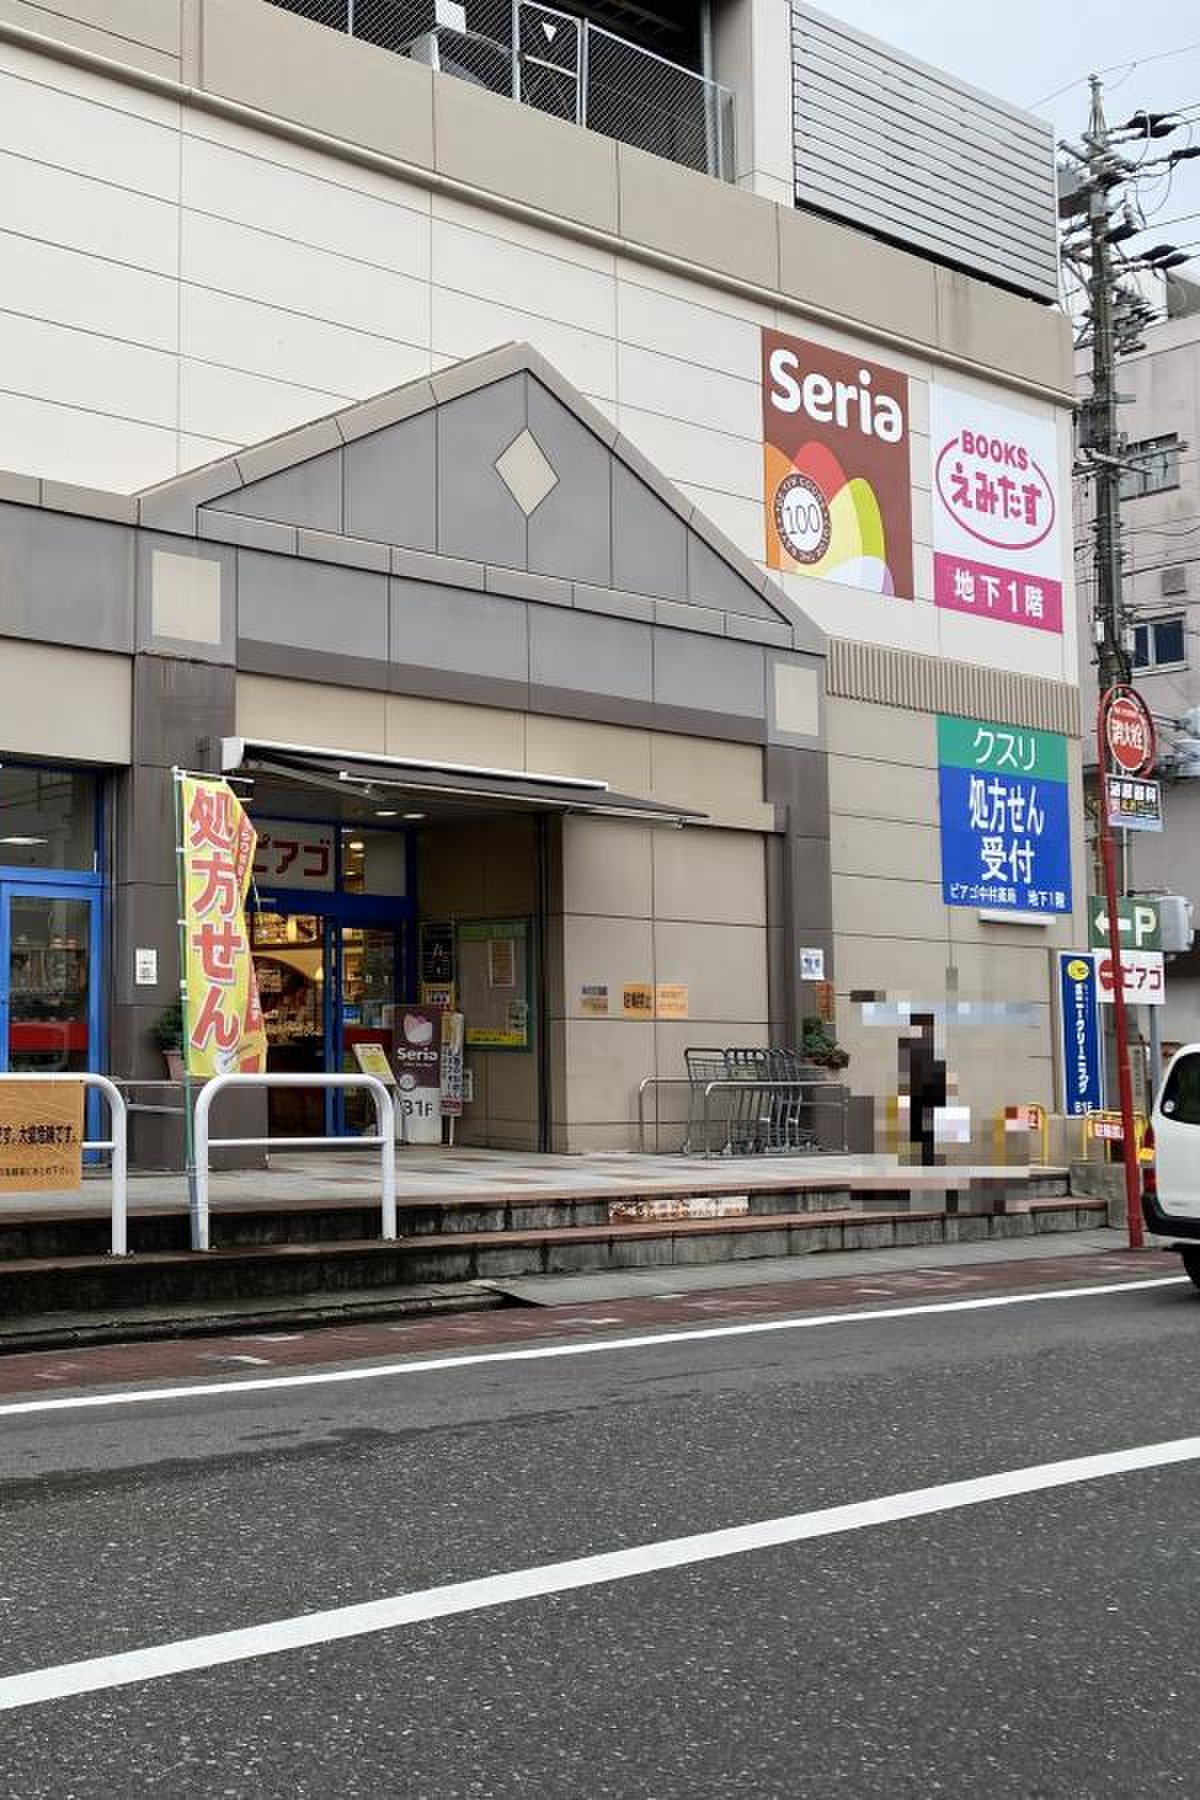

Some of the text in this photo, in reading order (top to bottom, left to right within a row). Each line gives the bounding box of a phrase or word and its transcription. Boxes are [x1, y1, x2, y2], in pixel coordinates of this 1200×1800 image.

[769, 349, 902, 442] Seria
[962, 430, 1029, 471] BOOKS
[784, 504, 820, 534] 100
[951, 462, 1042, 526] えみたす
[954, 567, 1044, 619] 地下1階
[973, 727, 1036, 771] クスリ
[969, 773, 1045, 836] 処方せん
[980, 837, 1036, 885] 受付
[188, 786, 242, 1050] 処方せん
[1135, 906, 1157, 947] P
